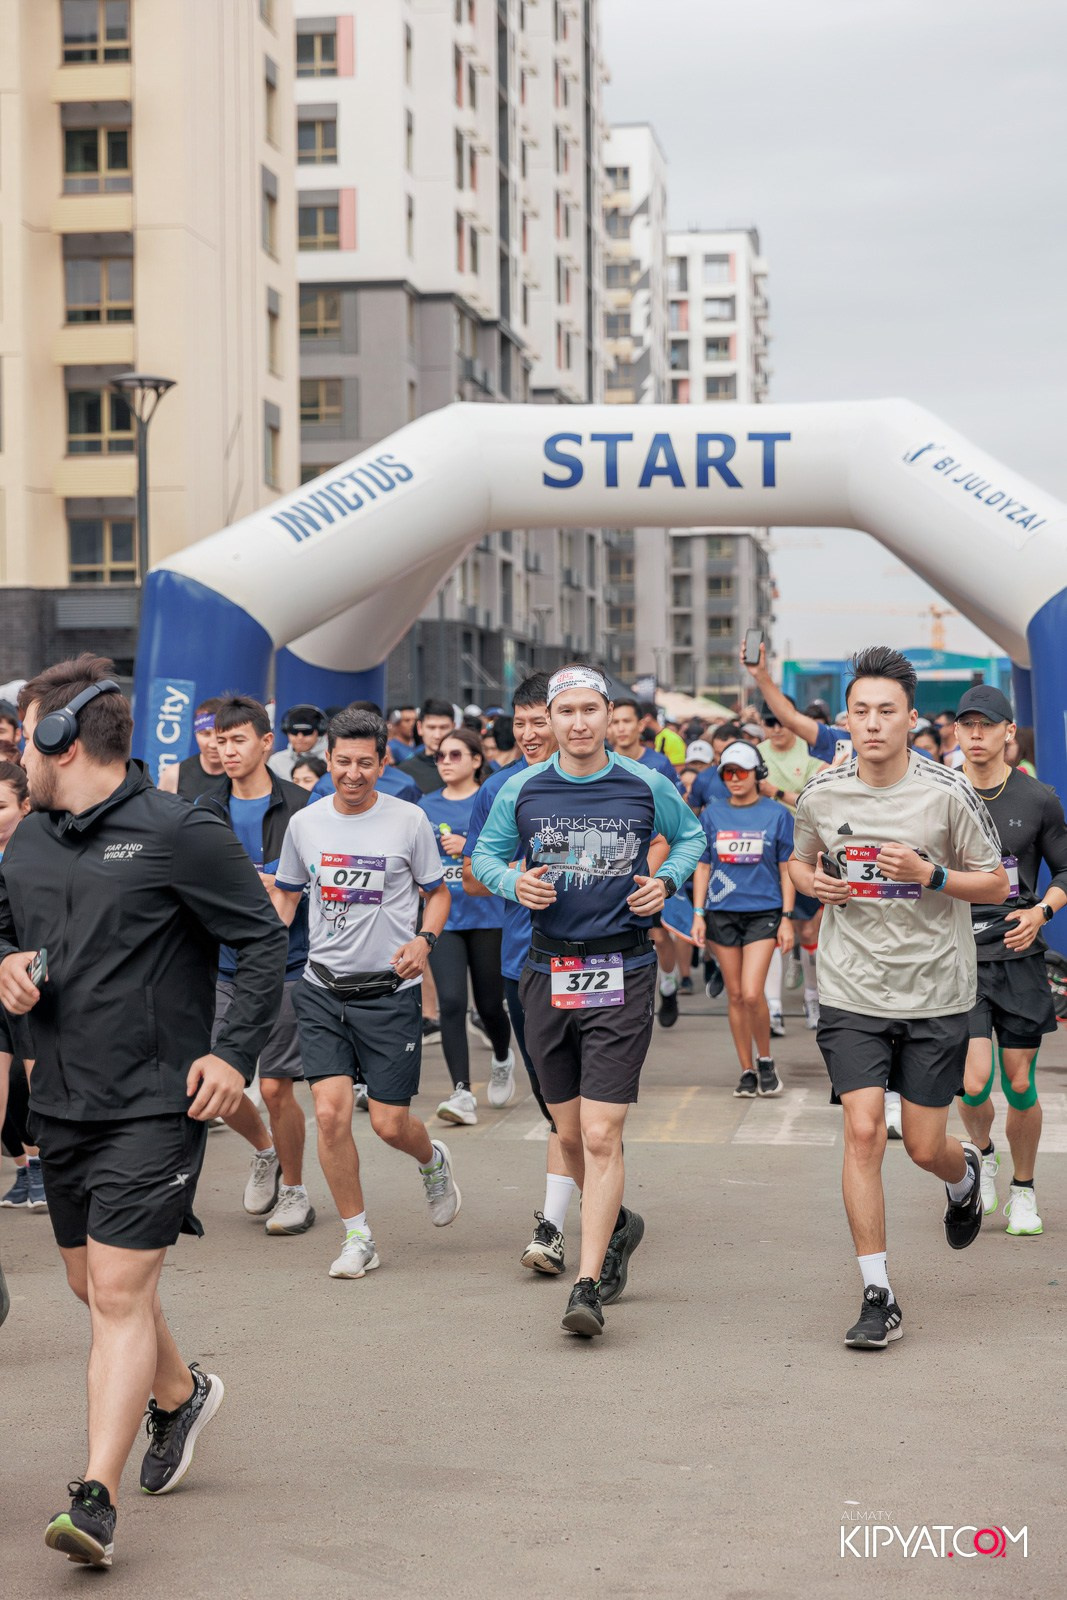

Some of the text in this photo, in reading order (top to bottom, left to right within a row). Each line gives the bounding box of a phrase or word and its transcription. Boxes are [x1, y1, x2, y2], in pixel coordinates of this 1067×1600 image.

[542, 432, 791, 488] START
[271, 454, 413, 542] INVICTUS
[933, 457, 1047, 531] BI JULDYZAI
[156, 685, 190, 744] City
[103, 851, 126, 860] WIDE
[104, 843, 143, 852] FAR AND
[728, 842, 751, 852] 011
[333, 869, 372, 888] 071
[860, 863, 888, 882] 34
[566, 971, 610, 992] 372
